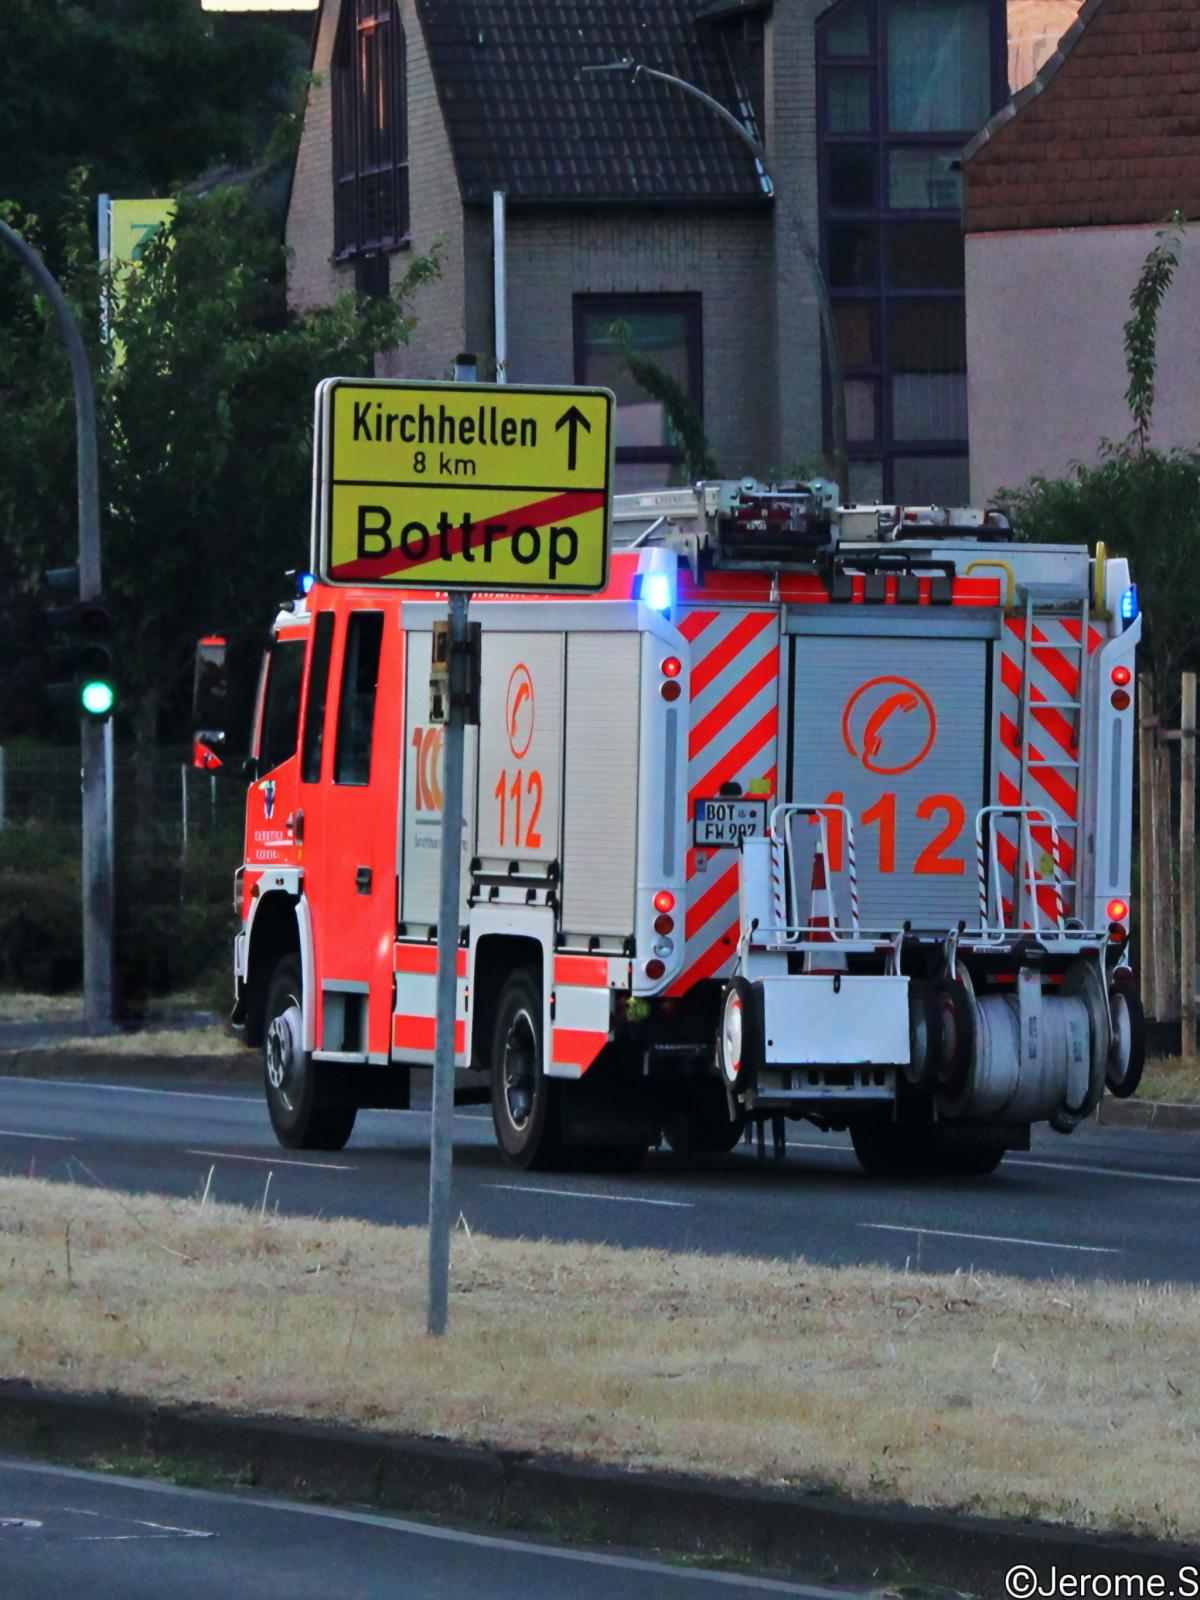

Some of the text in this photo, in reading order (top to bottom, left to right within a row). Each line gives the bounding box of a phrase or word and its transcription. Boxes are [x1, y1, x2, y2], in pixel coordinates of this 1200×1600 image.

[353, 401, 537, 447] Kirchhellen
[412, 452, 476, 476] 8 km
[357, 505, 579, 580] Bottrop
[495, 769, 543, 849] 112
[706, 803, 735, 821] BOT
[808, 791, 966, 874] 112
